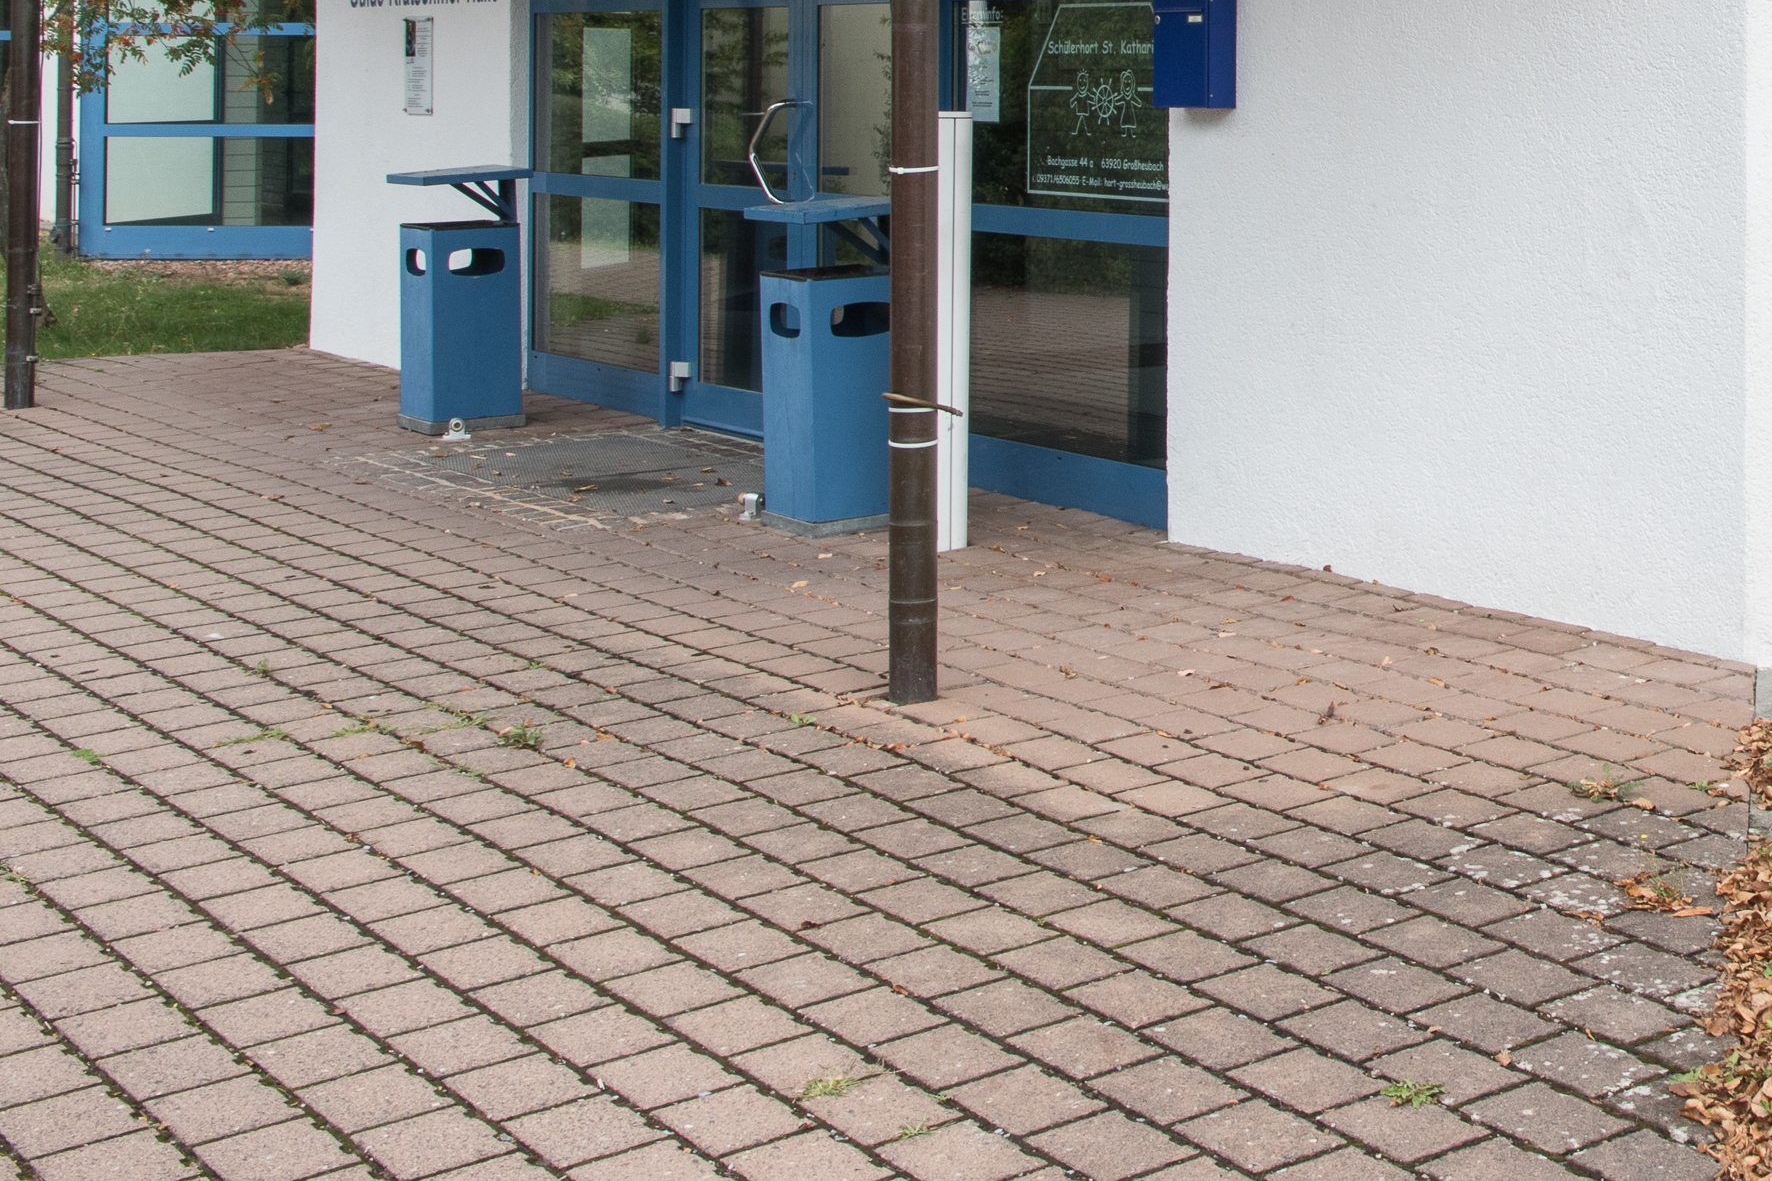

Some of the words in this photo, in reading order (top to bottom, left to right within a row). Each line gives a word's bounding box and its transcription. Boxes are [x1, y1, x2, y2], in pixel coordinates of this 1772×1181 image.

[1047, 39, 1099, 55] Schülerhort
[1101, 40, 1117, 55] St.
[1120, 39, 1154, 55] Kathari
[1047, 155, 1078, 169] Bachgasse
[1079, 157, 1088, 168] 44
[1101, 158, 1122, 170] 63920
[1122, 159, 1164, 171] Großheubach
[1104, 177, 1168, 191] hort-grossheubach@w
